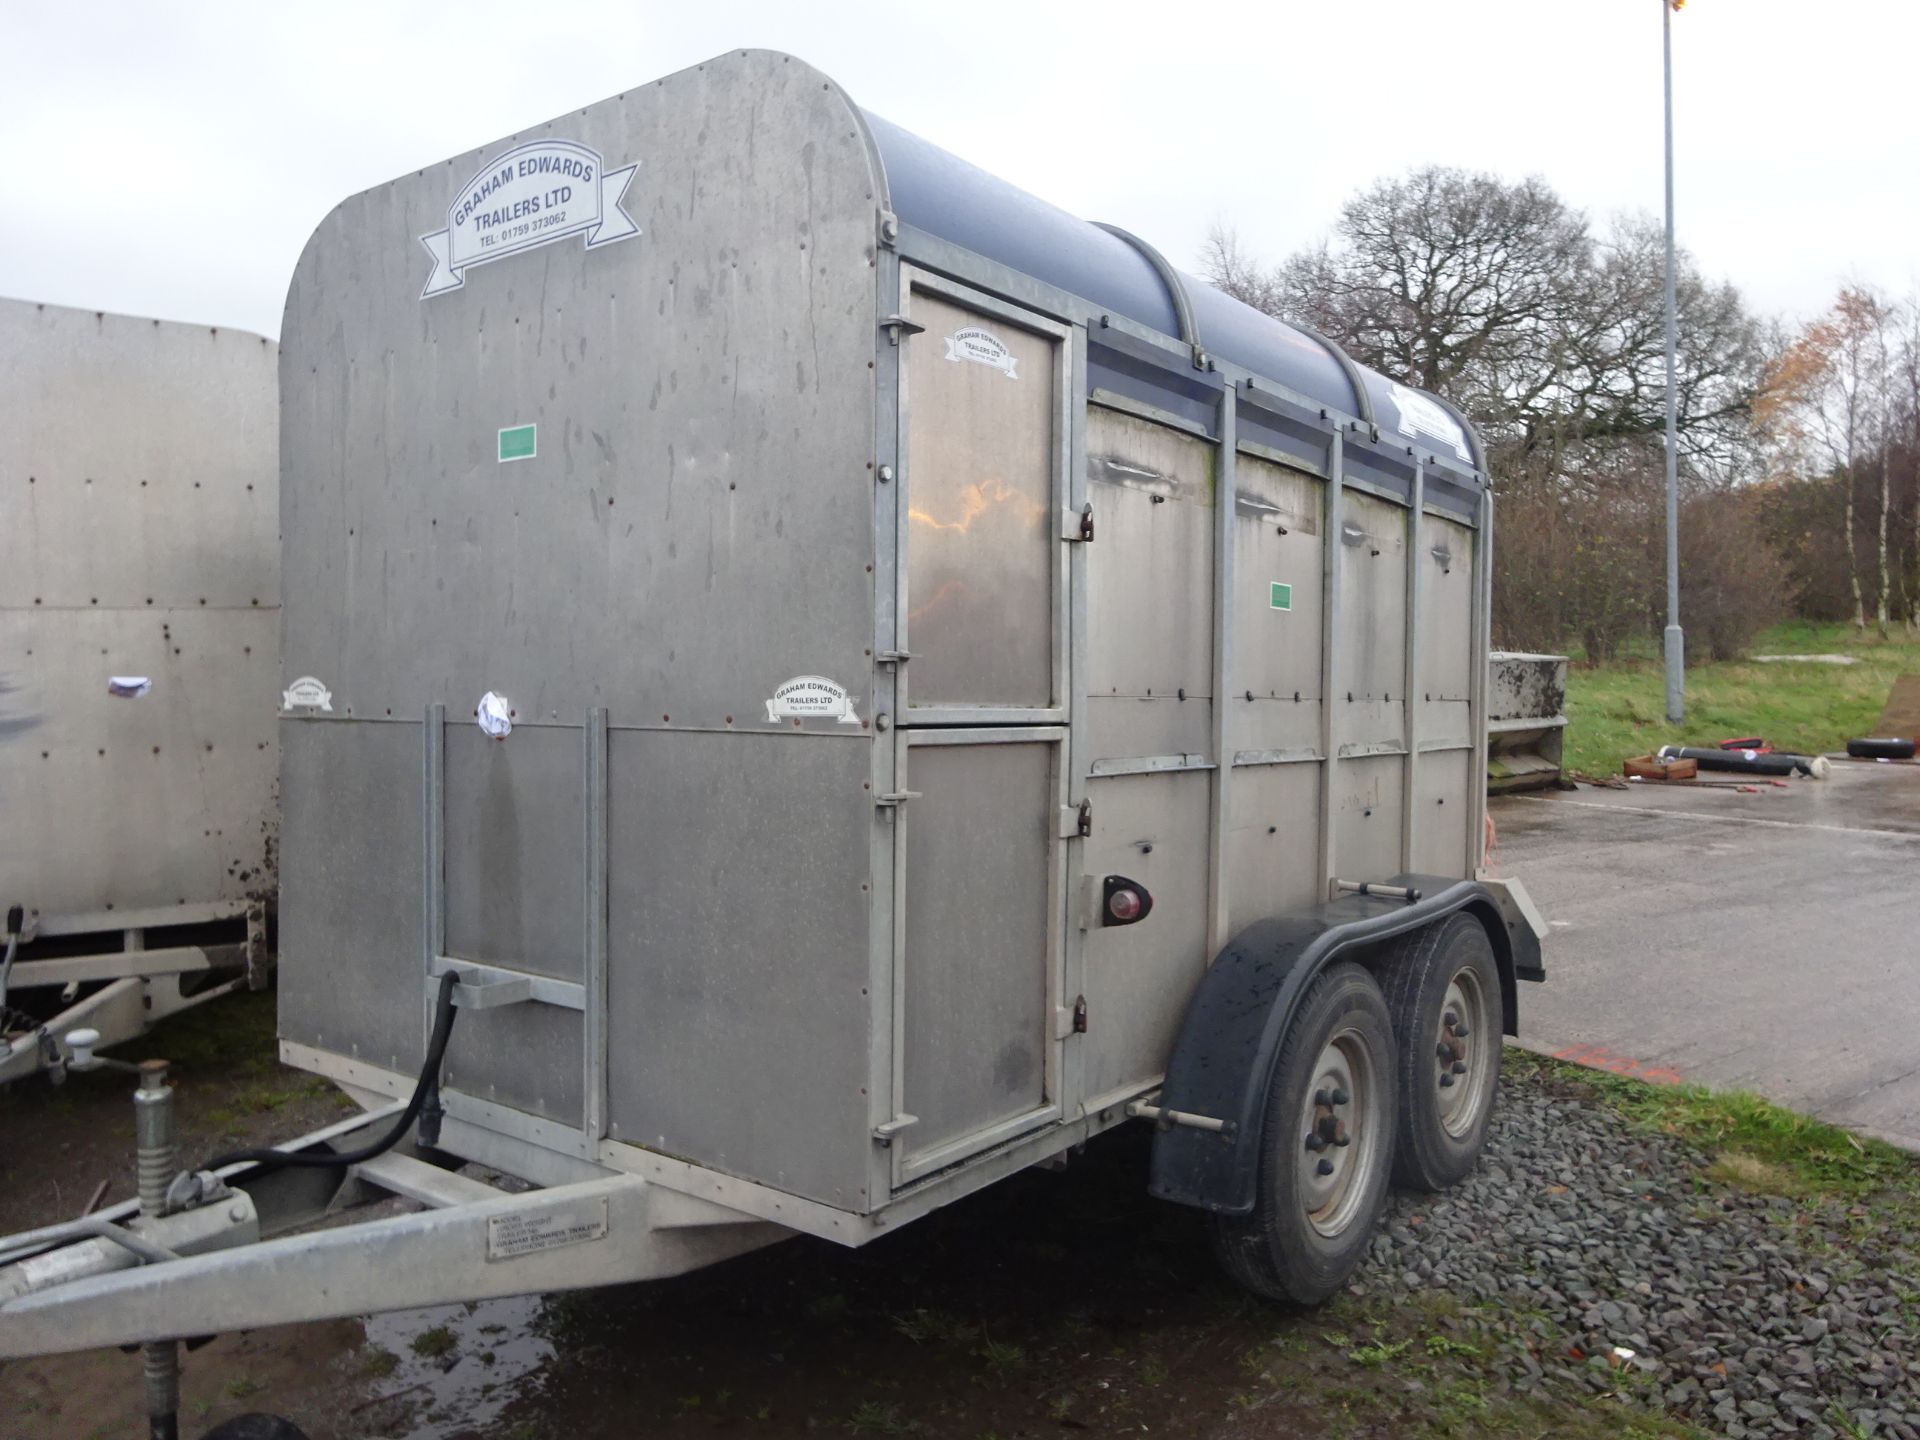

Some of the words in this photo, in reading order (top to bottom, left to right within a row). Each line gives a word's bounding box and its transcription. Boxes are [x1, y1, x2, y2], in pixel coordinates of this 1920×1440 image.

[454, 166, 514, 226] GRAHAM
[518, 156, 593, 183] EDWARDS
[474, 196, 540, 232] TRAILERS
[545, 186, 572, 209] LTD
[480, 234, 499, 248] TEL:
[502, 223, 529, 241] 01759
[532, 211, 566, 232] 373062
[956, 332, 980, 341] GRAHAM
[981, 333, 1007, 355] EDWARDS
[965, 342, 990, 355] TRAILERS
[776, 683, 805, 699] GRAHAM
[808, 683, 842, 699] EDWARDS
